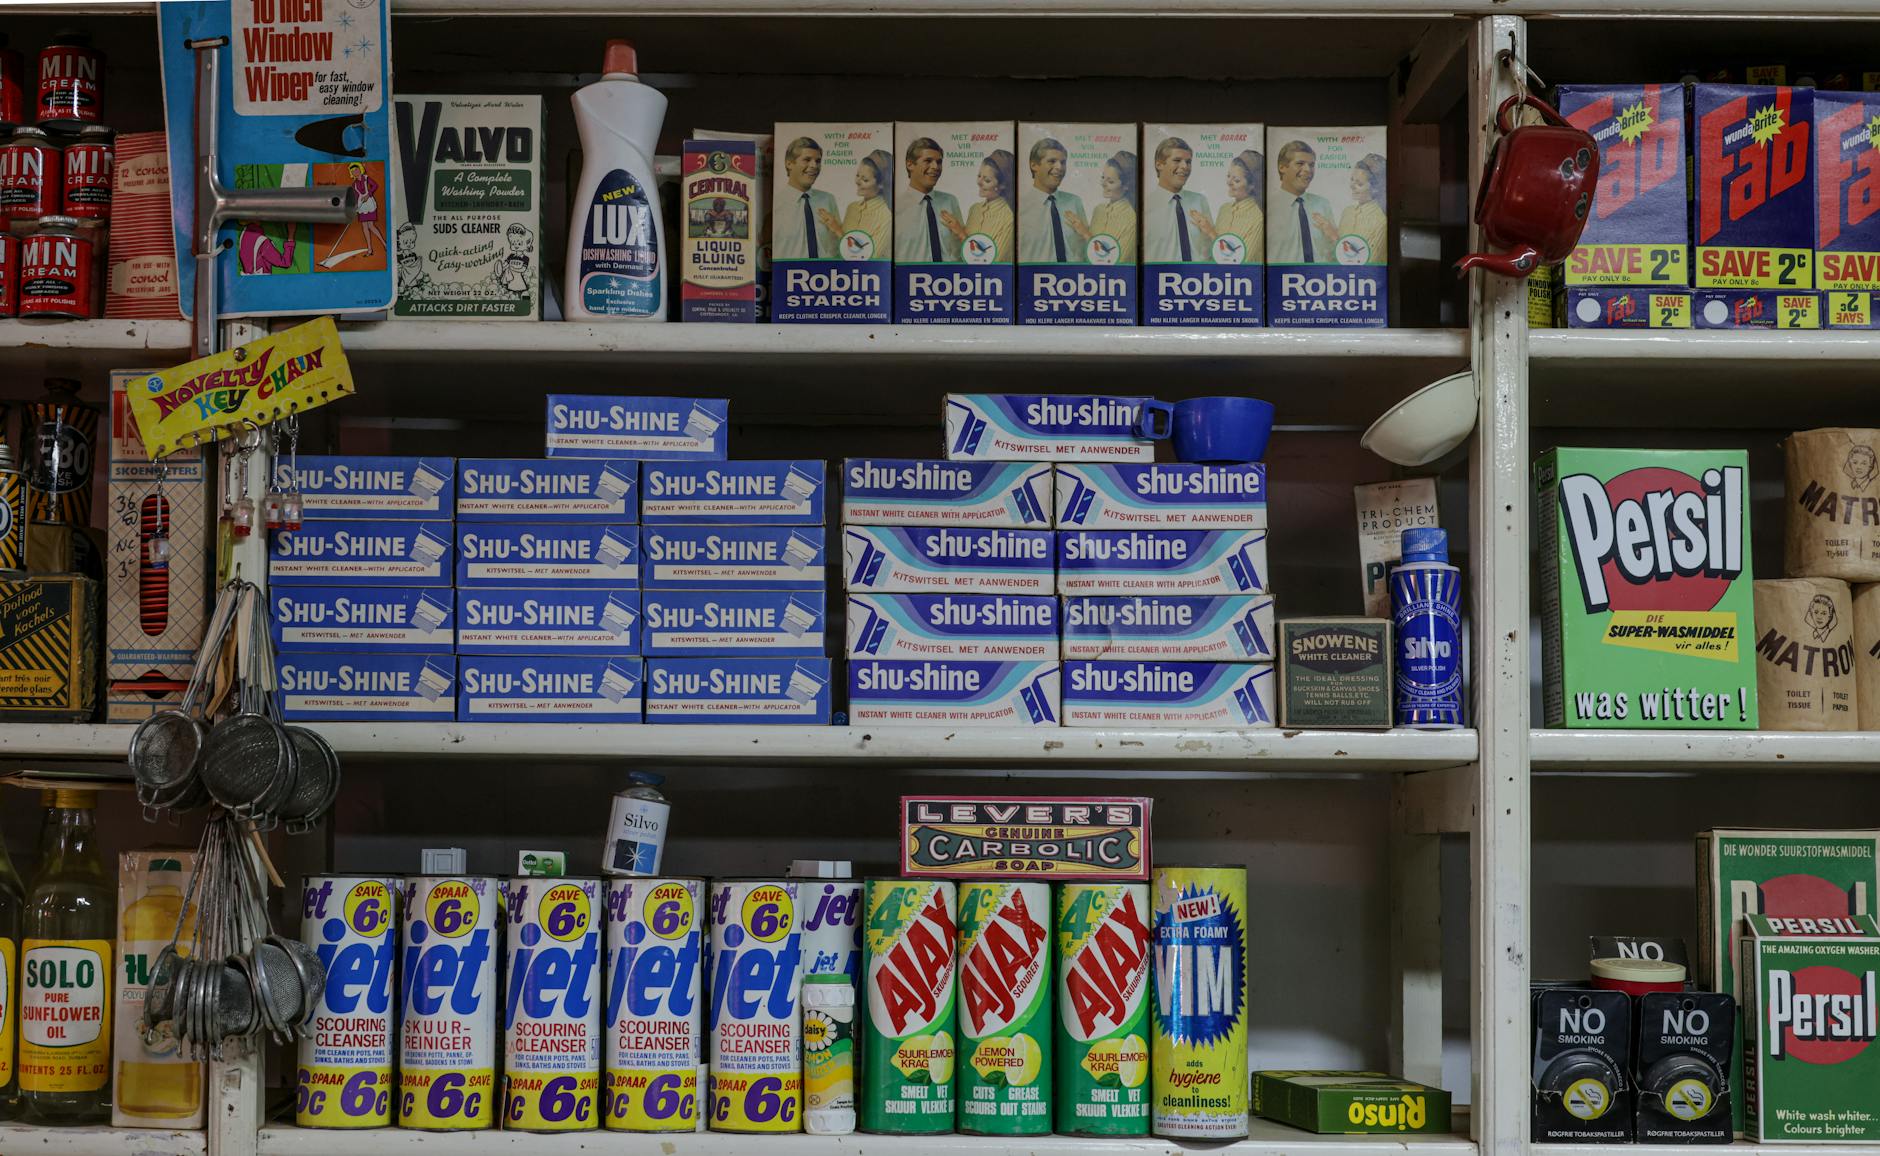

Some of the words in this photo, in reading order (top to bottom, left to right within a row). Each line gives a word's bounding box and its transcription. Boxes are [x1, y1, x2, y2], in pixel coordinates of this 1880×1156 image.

[243, 26, 333, 63] Window
[42, 55, 97, 80] MIN
[245, 66, 314, 102] Wiper
[315, 71, 327, 83] for
[330, 71, 349, 83] fast,
[42, 79, 96, 91] CREAM
[319, 83, 339, 95] easy
[342, 81, 375, 93] window
[323, 94, 363, 106] cleaning!
[395, 102, 533, 225] VALVO
[1700, 86, 1809, 245] Fab
[454, 172, 464, 182] A
[468, 172, 512, 185] Complete
[441, 186, 485, 199] Washing
[489, 186, 525, 197] Powder
[602, 185, 637, 201] NEW
[688, 177, 749, 201] CENTRAL
[433, 223, 457, 234] SUDS
[461, 223, 501, 234] CLEANER
[593, 204, 650, 246] LUX
[22, 238, 77, 267] MIN
[429, 240, 494, 263] Quick-acting
[697, 241, 742, 252] LIQUID
[437, 247, 505, 272] Easy-working
[583, 248, 632, 262] DISHWASHING
[692, 253, 745, 265] BLUING
[1702, 250, 1770, 278] SAVE
[22, 268, 77, 277] CREAM
[786, 269, 880, 292] Robin
[909, 273, 1003, 296] Robin
[410, 304, 453, 313] ATTACKS
[457, 304, 480, 313] DIRT
[482, 304, 516, 313] FASTER
[787, 295, 880, 307] STARCH
[909, 299, 1003, 312] STYSEL
[1783, 298, 1812, 308] SAVE
[148, 344, 275, 423] NOVELTY
[194, 387, 250, 421] KEY
[257, 346, 325, 400] CHAIN
[553, 404, 679, 431] SHU-SHINE
[994, 439, 1051, 454] KITSWITSEL
[1056, 445, 1075, 453] MET
[1080, 446, 1140, 455] AANWENDER
[850, 509, 880, 518] INSTANT
[881, 509, 906, 518] WHITE
[907, 509, 940, 519] CLEANER
[941, 509, 960, 518] WITH
[961, 507, 1006, 519] APPLICATOR
[1361, 505, 1435, 520] TRI-CHEM
[1362, 516, 1436, 531] PRODUCT
[1559, 466, 1743, 614] Persil
[649, 535, 777, 561] SHU-SHINE
[277, 597, 406, 624] SHU-SHINE
[1646, 614, 1664, 623] DIE
[1608, 625, 1735, 640] SUPER-WASMIDDEL
[1292, 634, 1378, 654] SNOWENE
[1675, 642, 1692, 650] vir
[1298, 653, 1328, 661] WHITE
[1331, 653, 1372, 661] CLEANER
[1786, 690, 1811, 698] TOILET
[1576, 691, 1629, 720] was
[1787, 702, 1811, 710] TISSUE
[917, 803, 1133, 826] LEVER'S
[624, 813, 659, 832] Silvo
[985, 827, 1065, 839] GENUINE
[929, 834, 1121, 865] CARBOLIC
[1724, 844, 1737, 856] DIE
[1739, 845, 1777, 857] WONDER
[1780, 845, 1872, 858] SUURSTOFWASMIDDEL
[995, 861, 1055, 872] SOAP
[433, 886, 469, 899] SPAAR
[549, 890, 580, 901] SAVE
[1160, 926, 1189, 939] EXTRA
[1194, 926, 1228, 938] FOAMY
[1766, 917, 1864, 935] PERSIL
[1762, 944, 1777, 954] THE
[1778, 944, 1814, 954] AMAZING
[1815, 944, 1846, 955] OXYGEN
[1848, 945, 1880, 956] WASHER
[960, 888, 1047, 1036] AJAX
[27, 959, 94, 989] SOLO
[401, 920, 490, 1027] jet
[505, 922, 598, 1029] jet
[1013, 962, 1040, 999] SCOURER
[1155, 945, 1233, 1017] VIM
[44, 992, 70, 1003] PURE
[23, 1006, 100, 1024] SUNFLOWER
[1559, 1008, 1606, 1034] NO
[1768, 969, 1876, 1060] Persil
[47, 1026, 66, 1040] OIL
[515, 1022, 587, 1037] SCOURING
[404, 1036, 471, 1050] REINIGER
[515, 1038, 587, 1053] CLEANSER
[1557, 1034, 1605, 1045] SMOKING
[979, 1047, 1015, 1057] LEMON
[975, 1057, 1024, 1068] POWERED
[1091, 1062, 1119, 1072] KRAG
[1186, 1060, 1203, 1068] adds
[1169, 1068, 1221, 1088] hygiene
[972, 1086, 995, 1100] CUTS
[1008, 1086, 1039, 1101] GREASE
[1091, 1088, 1119, 1102] SMELT
[1128, 1088, 1141, 1102] VET
[965, 1101, 997, 1116] SCOURS
[1000, 1101, 1018, 1115] OUT
[1022, 1101, 1047, 1116] STAINS
[1163, 1095, 1231, 1108] cleanliness!
[1076, 1103, 1107, 1118] SKUUR
[1111, 1103, 1140, 1118] VLEKKE
[1348, 1094, 1426, 1131] Rinso
[1776, 1109, 1806, 1121] White
[1809, 1109, 1835, 1121] wash
[1574, 1130, 1625, 1138] TOBAKSPASTILLER
[1784, 1123, 1822, 1135] Colours
[1825, 1123, 1866, 1137] brighter
